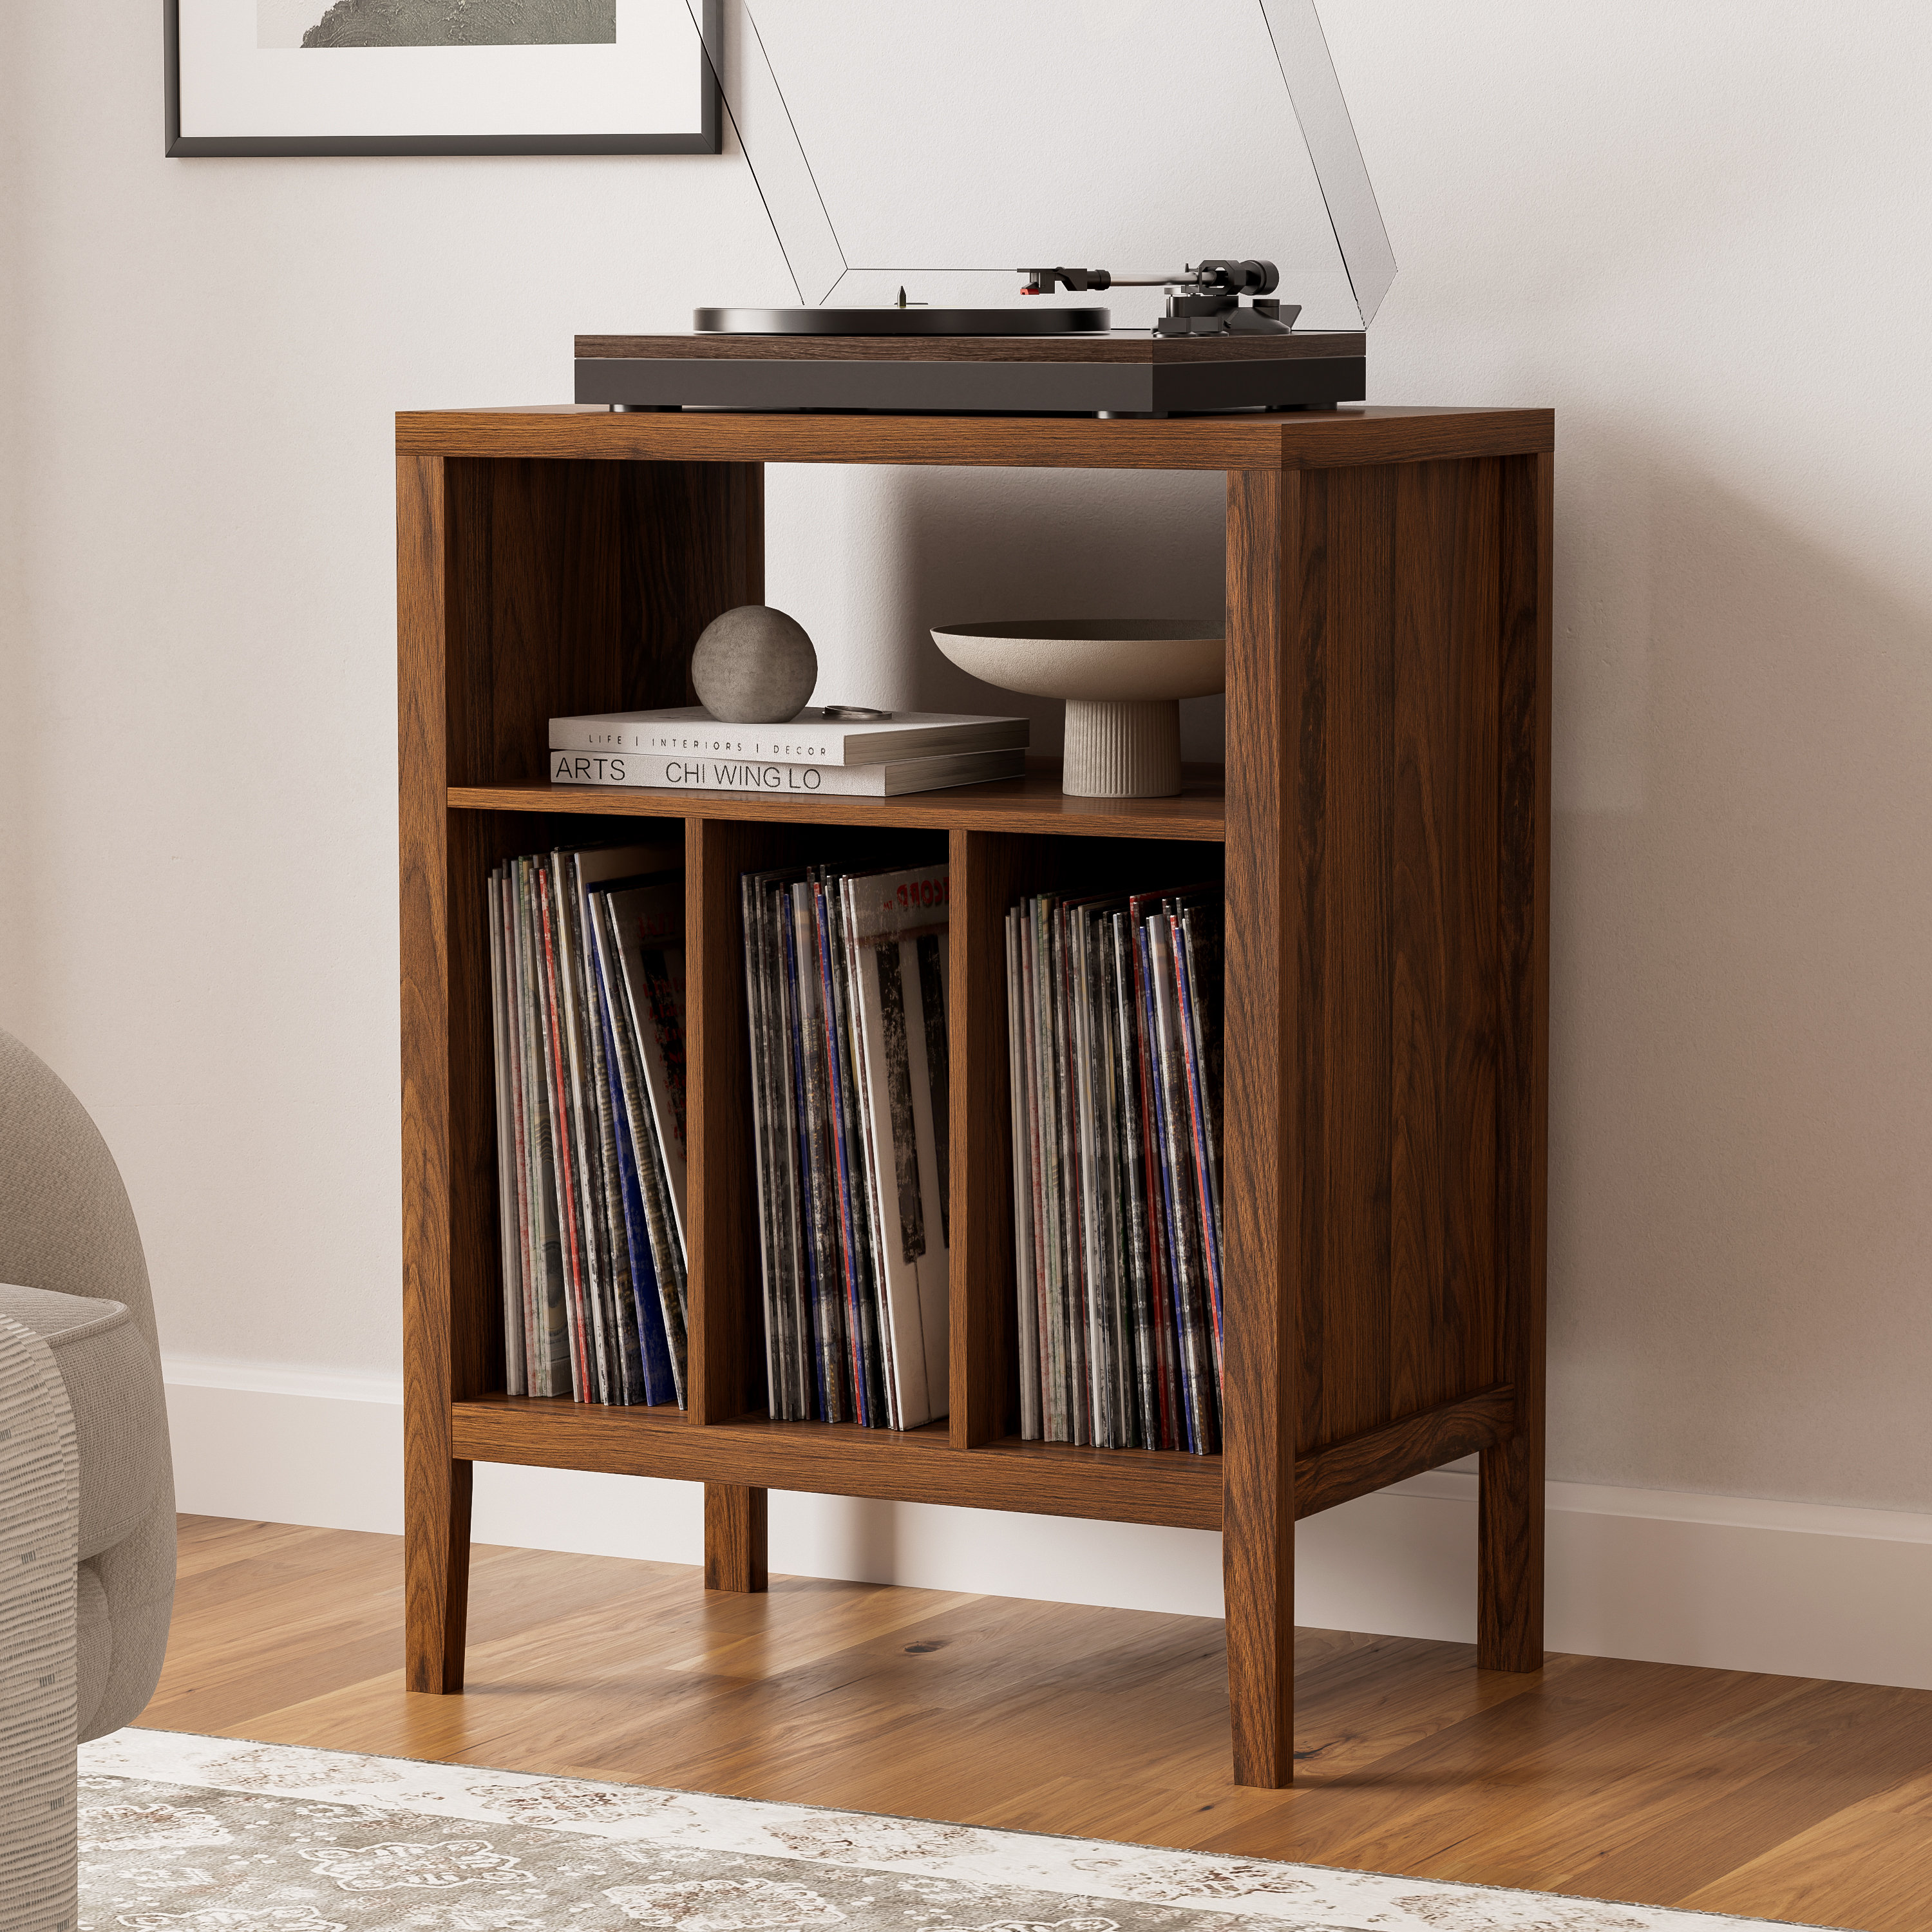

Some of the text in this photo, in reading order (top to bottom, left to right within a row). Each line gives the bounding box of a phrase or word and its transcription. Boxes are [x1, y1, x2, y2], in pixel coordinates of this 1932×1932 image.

[589, 735, 826, 755] LIFE INTERIORS DECOR
[556, 757, 821, 790] ARTS CHI WING LO
